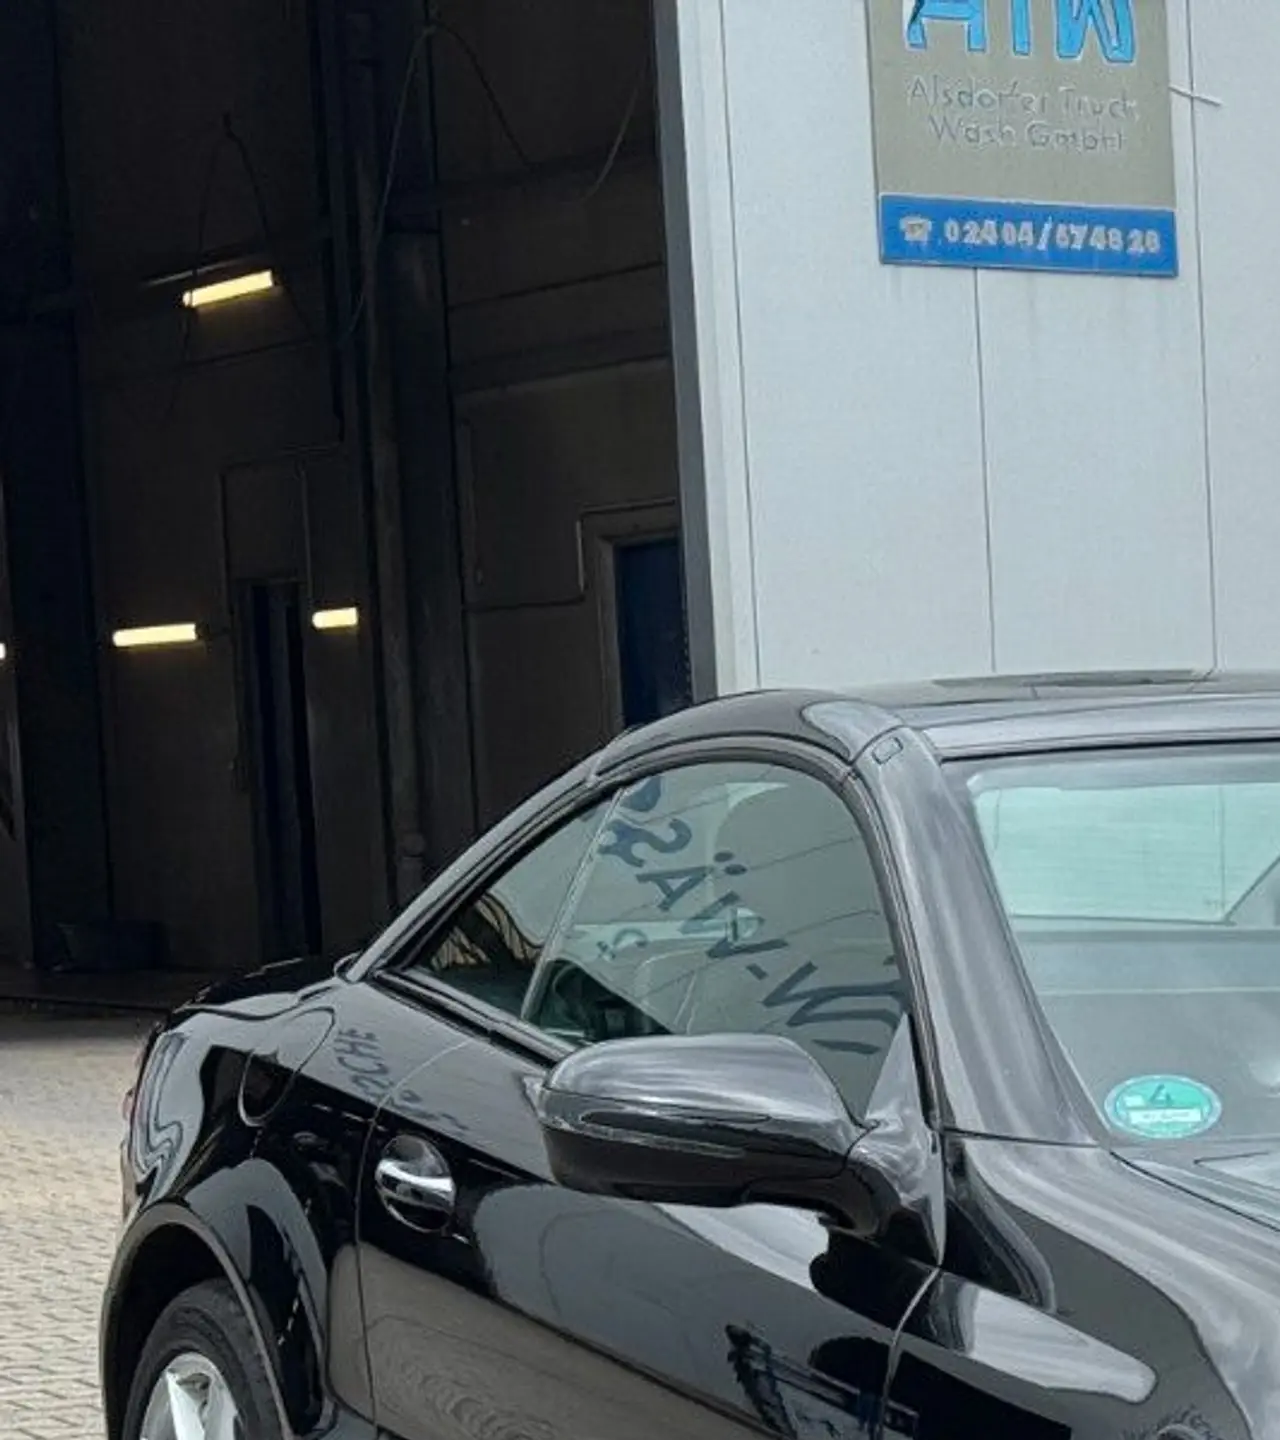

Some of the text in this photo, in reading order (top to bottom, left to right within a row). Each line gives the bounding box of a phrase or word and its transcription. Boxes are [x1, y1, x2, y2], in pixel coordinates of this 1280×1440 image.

[909, 75, 1138, 120] Alsdorfer Truck
[929, 116, 1125, 151] Wash GmbH
